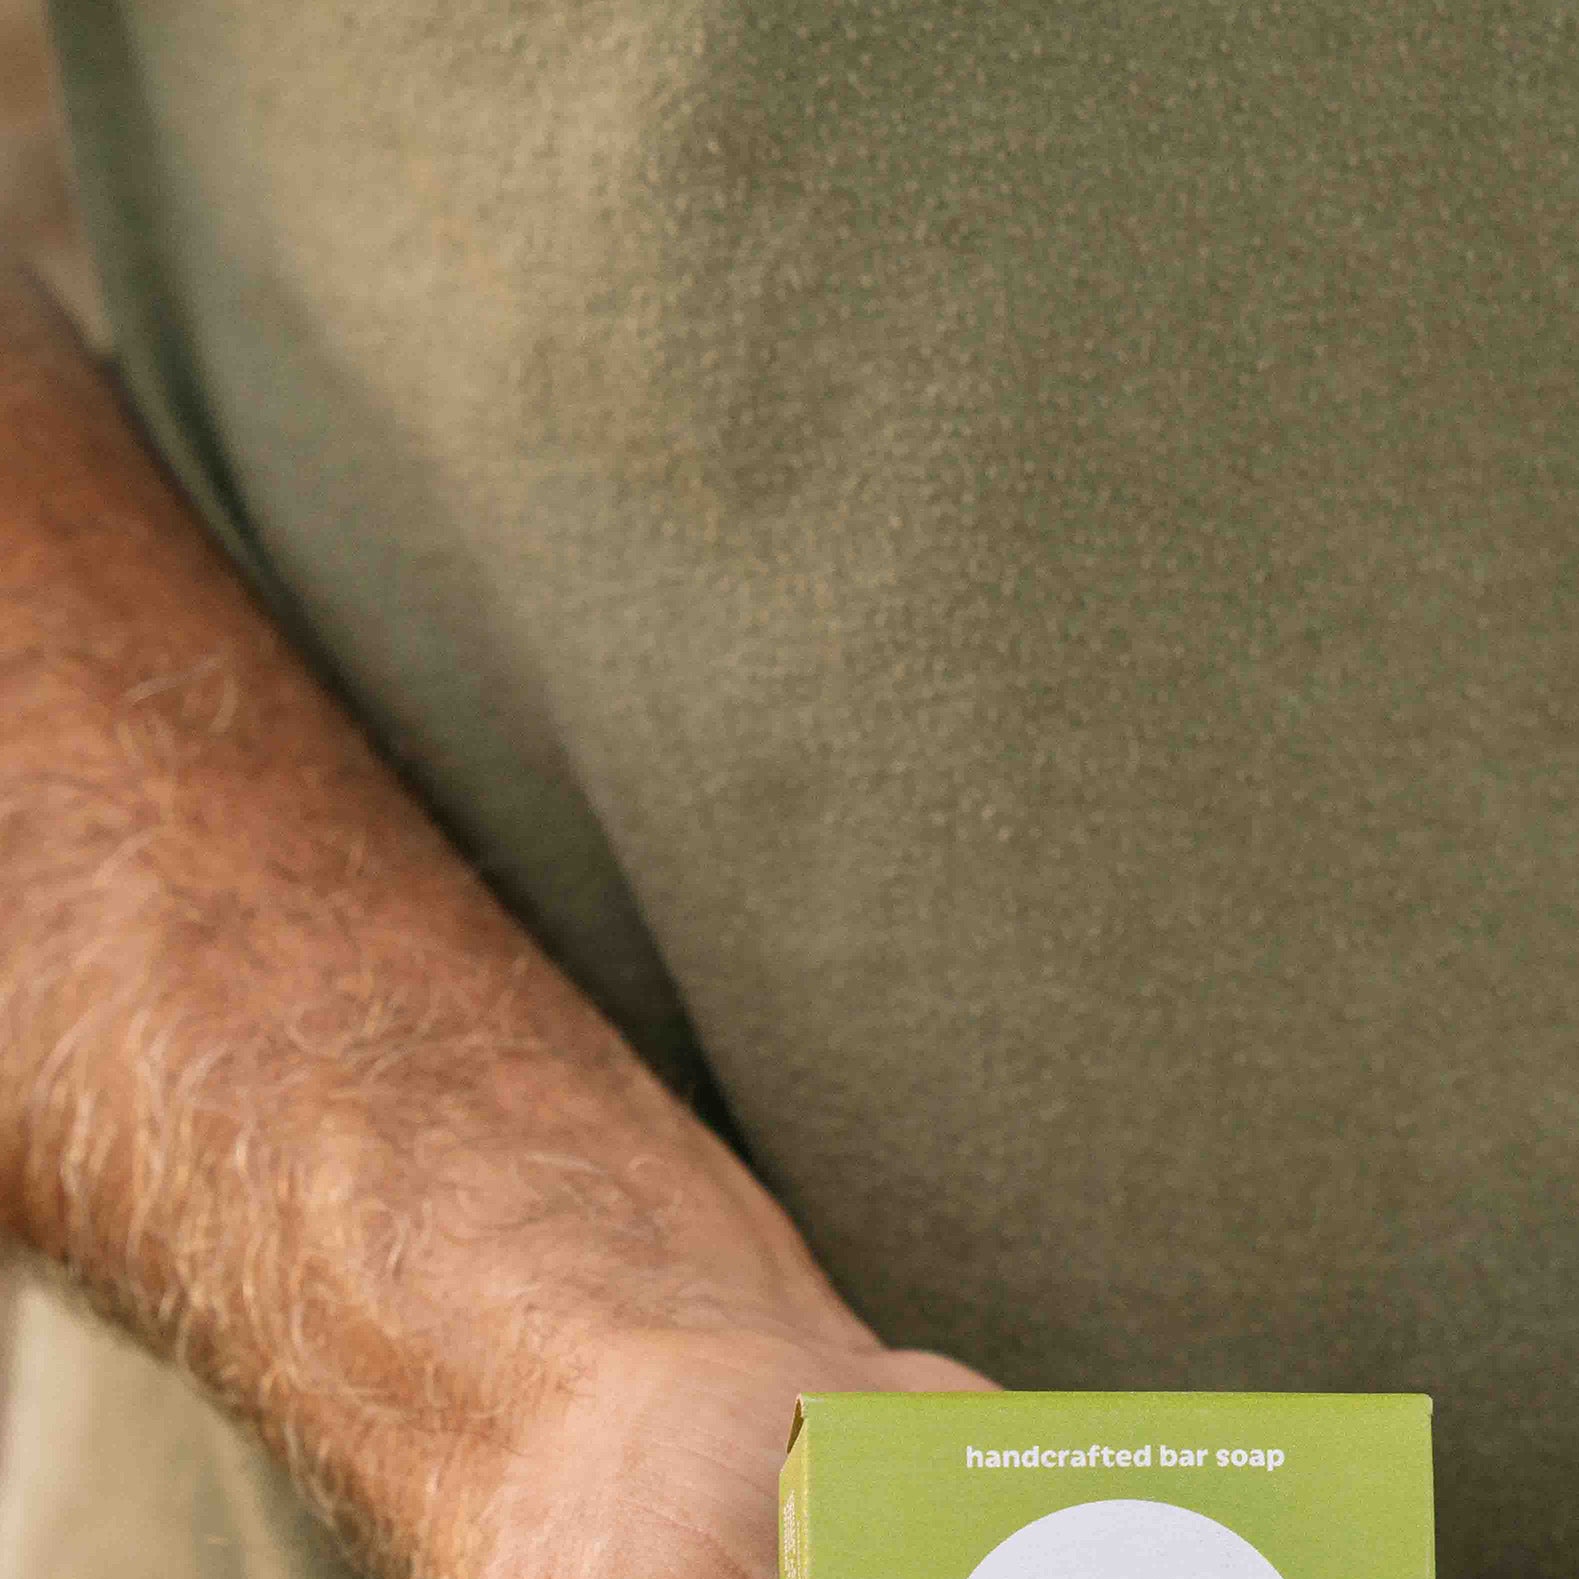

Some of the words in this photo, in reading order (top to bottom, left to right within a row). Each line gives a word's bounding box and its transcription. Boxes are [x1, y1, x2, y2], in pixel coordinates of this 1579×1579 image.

[966, 1445, 1151, 1468] handcrafted
[1159, 1445, 1208, 1467] bar
[1216, 1446, 1285, 1471] soap
